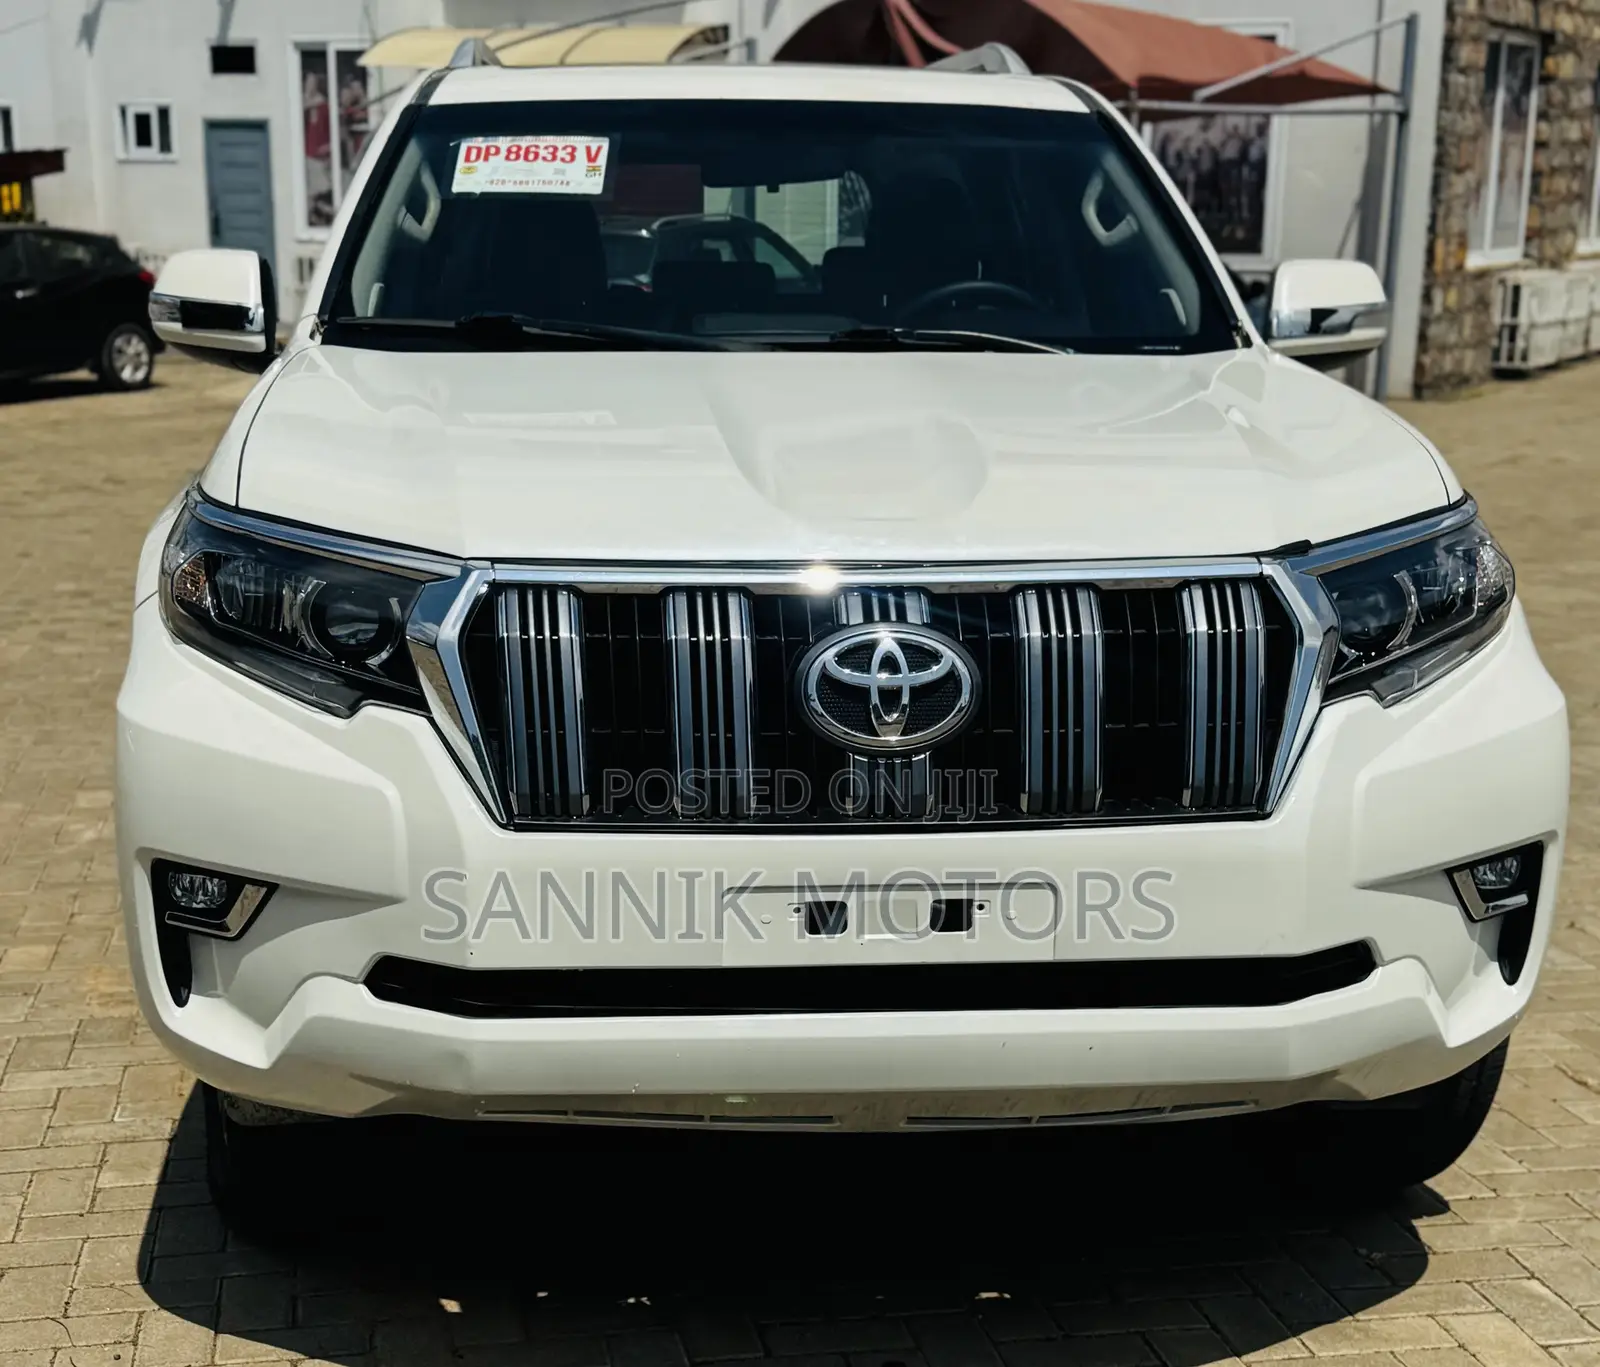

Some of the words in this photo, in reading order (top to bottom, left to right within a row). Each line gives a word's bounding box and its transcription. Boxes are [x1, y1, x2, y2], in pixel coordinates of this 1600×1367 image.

[464, 145, 501, 164] DP
[504, 144, 577, 164] 8633
[585, 145, 603, 164] V
